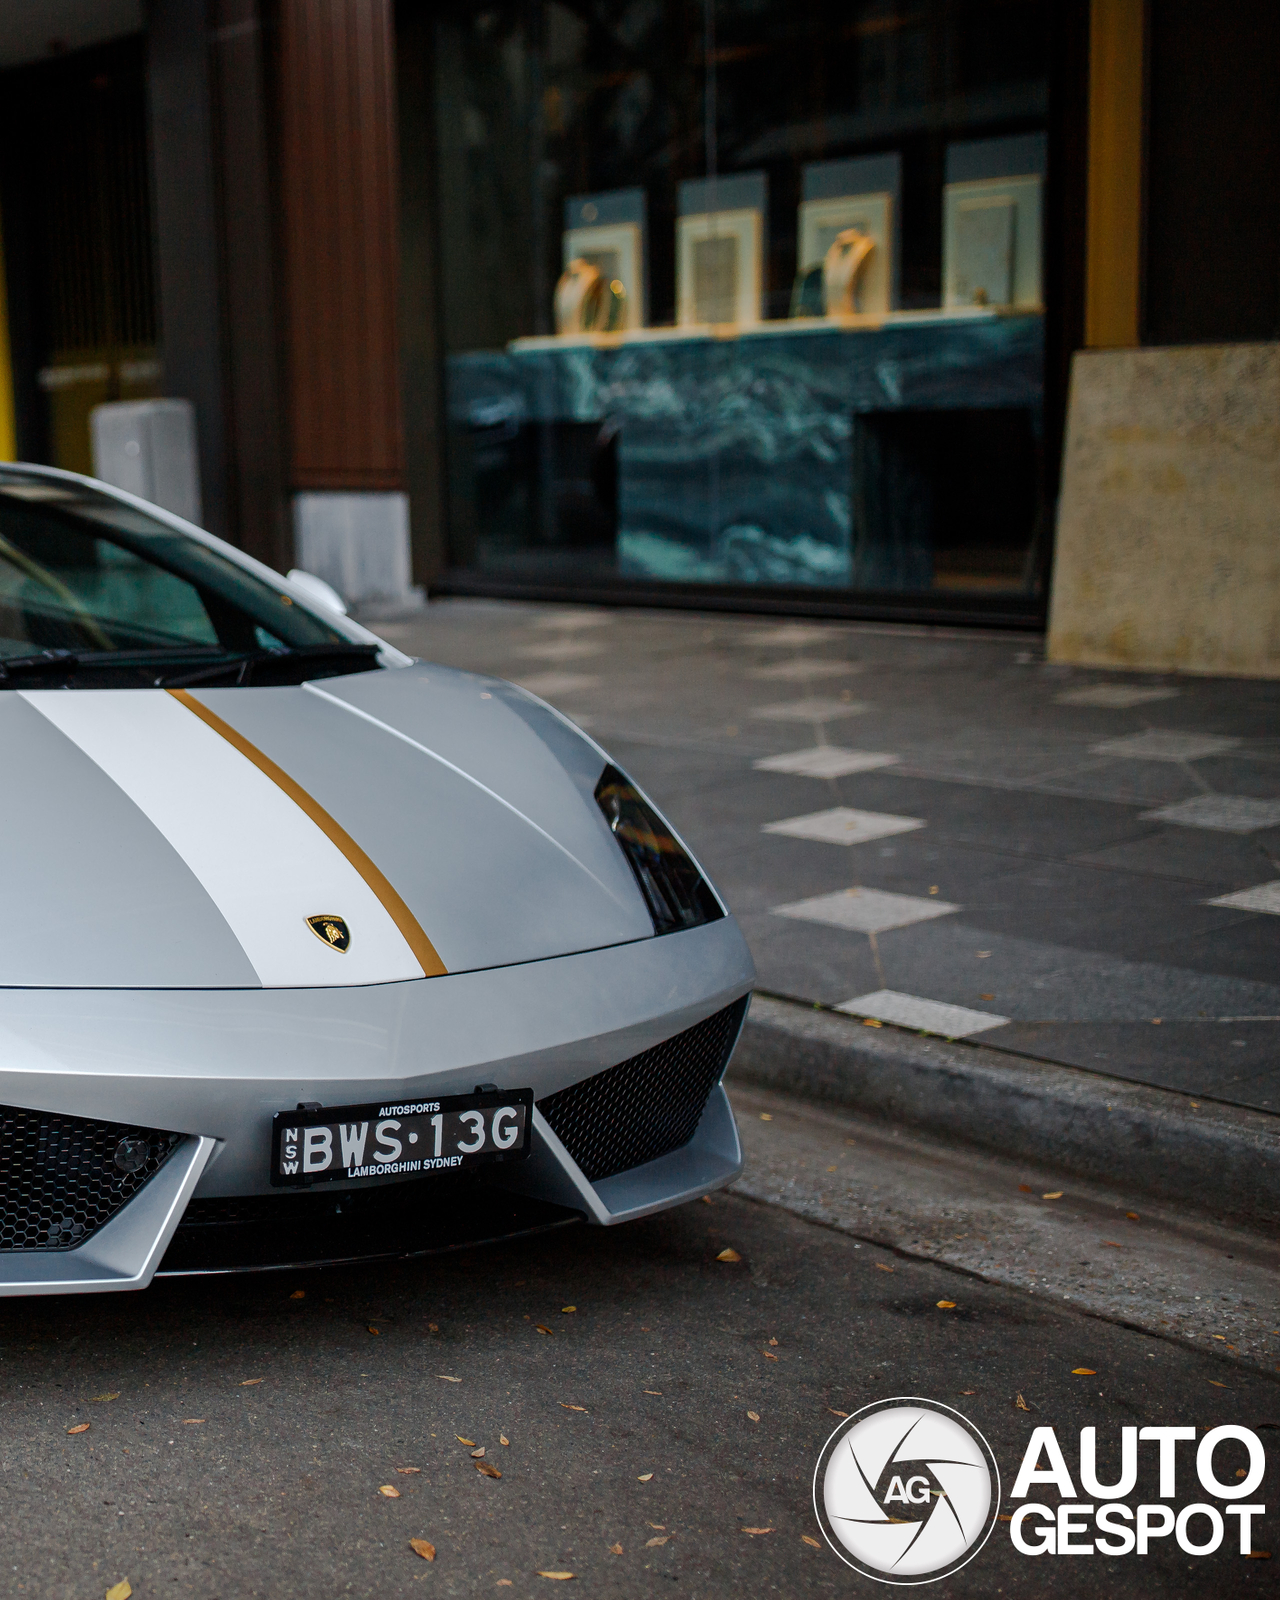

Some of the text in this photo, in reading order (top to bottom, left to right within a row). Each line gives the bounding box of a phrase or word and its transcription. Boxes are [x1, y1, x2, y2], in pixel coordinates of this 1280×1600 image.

[378, 1102, 441, 1117] AUTOSPORTS
[347, 1155, 464, 1178] LAMBORGHINI SYDNEY
